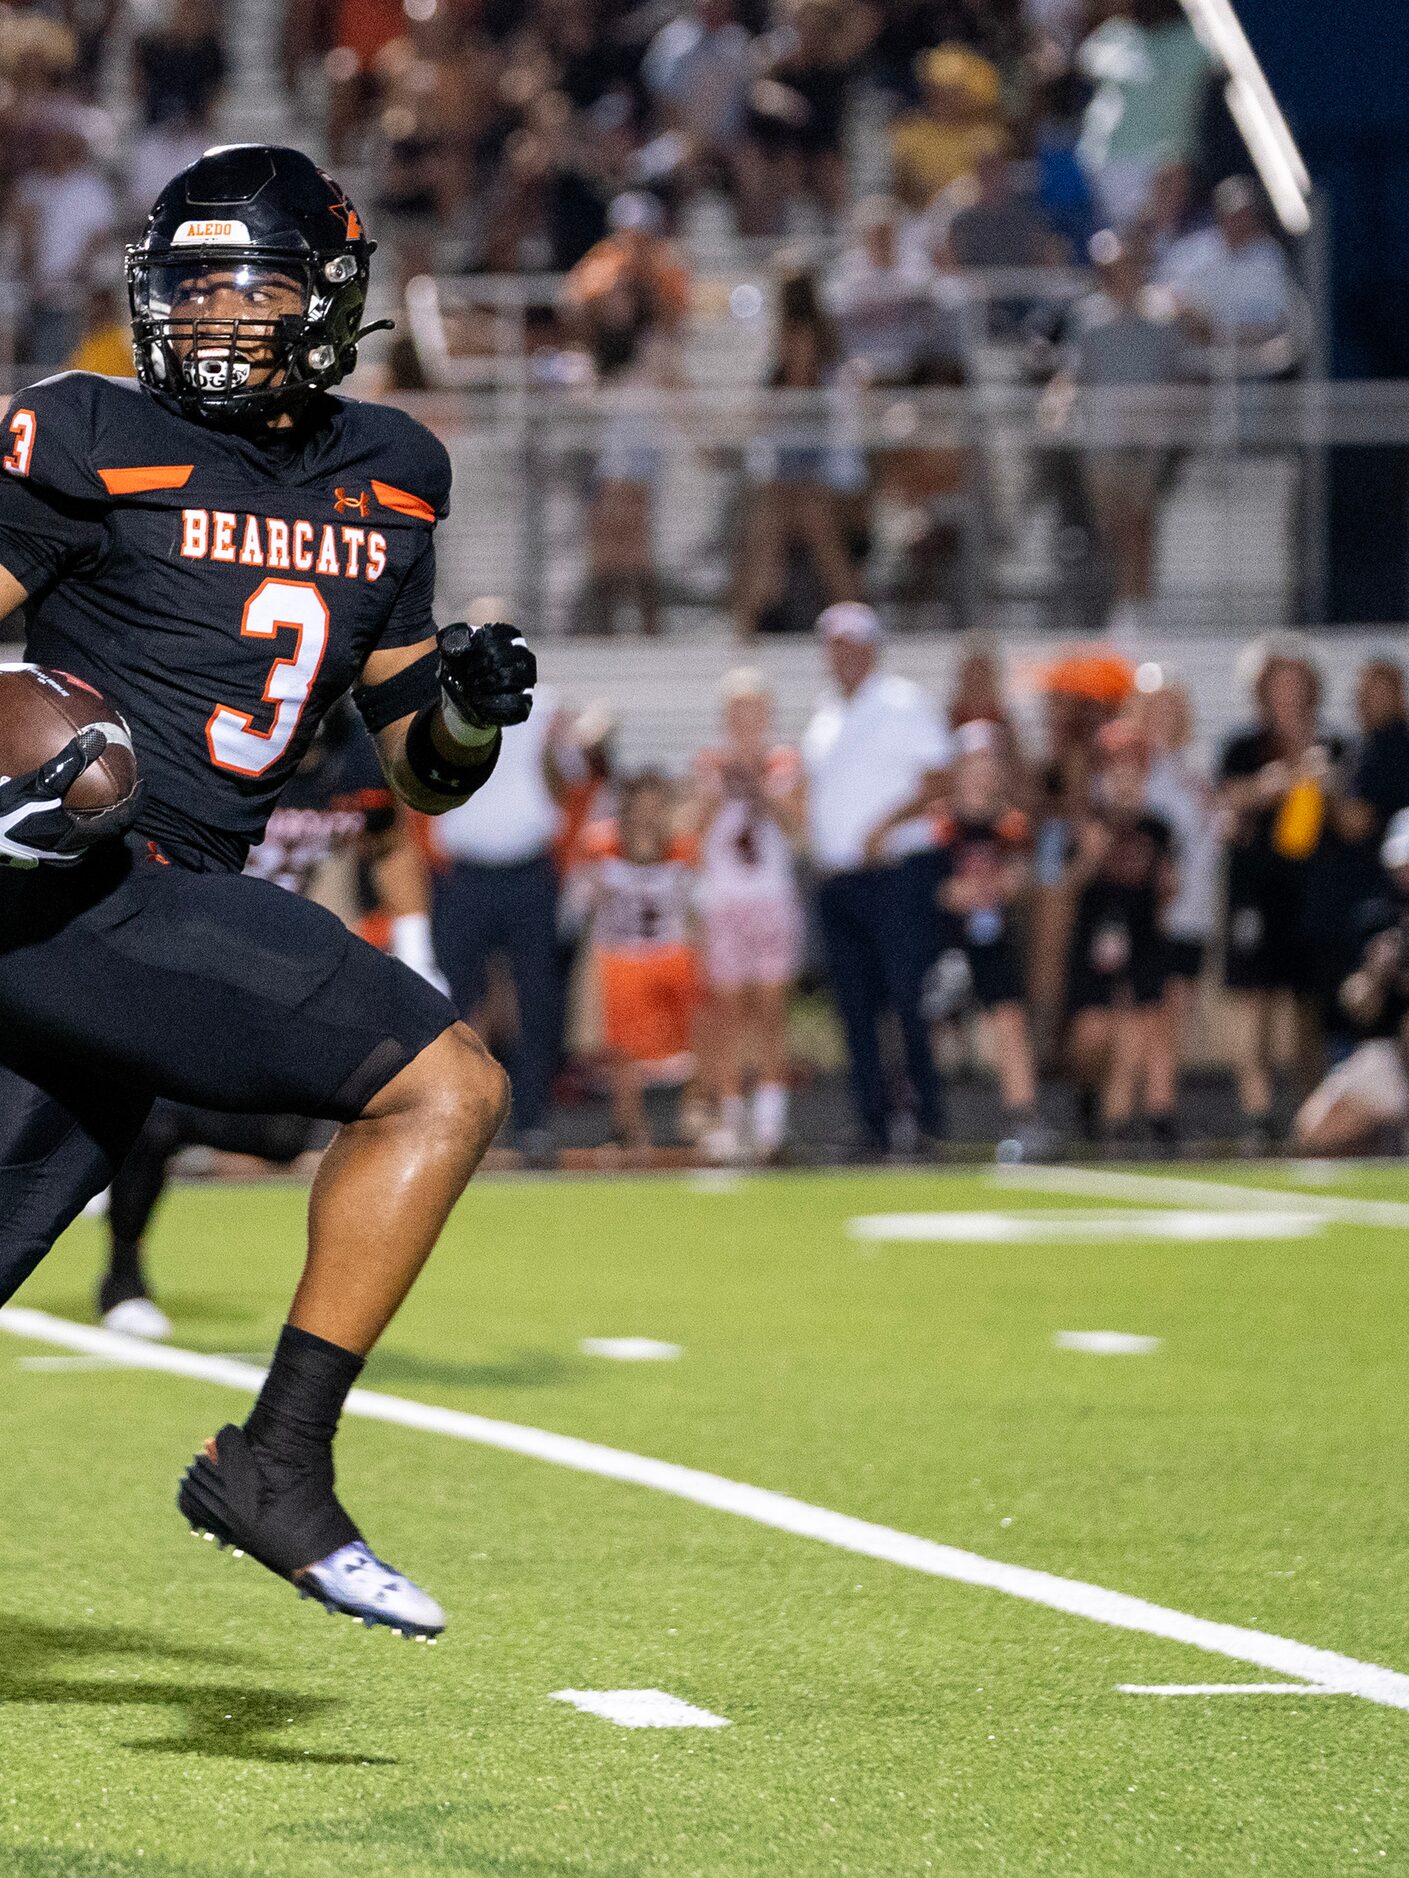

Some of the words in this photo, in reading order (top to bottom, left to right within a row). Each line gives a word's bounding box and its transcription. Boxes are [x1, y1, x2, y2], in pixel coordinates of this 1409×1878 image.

[187, 223, 232, 237] ALEDO
[2, 408, 37, 477] 3
[180, 508, 388, 582] BEARCATS
[205, 576, 330, 777] 3
